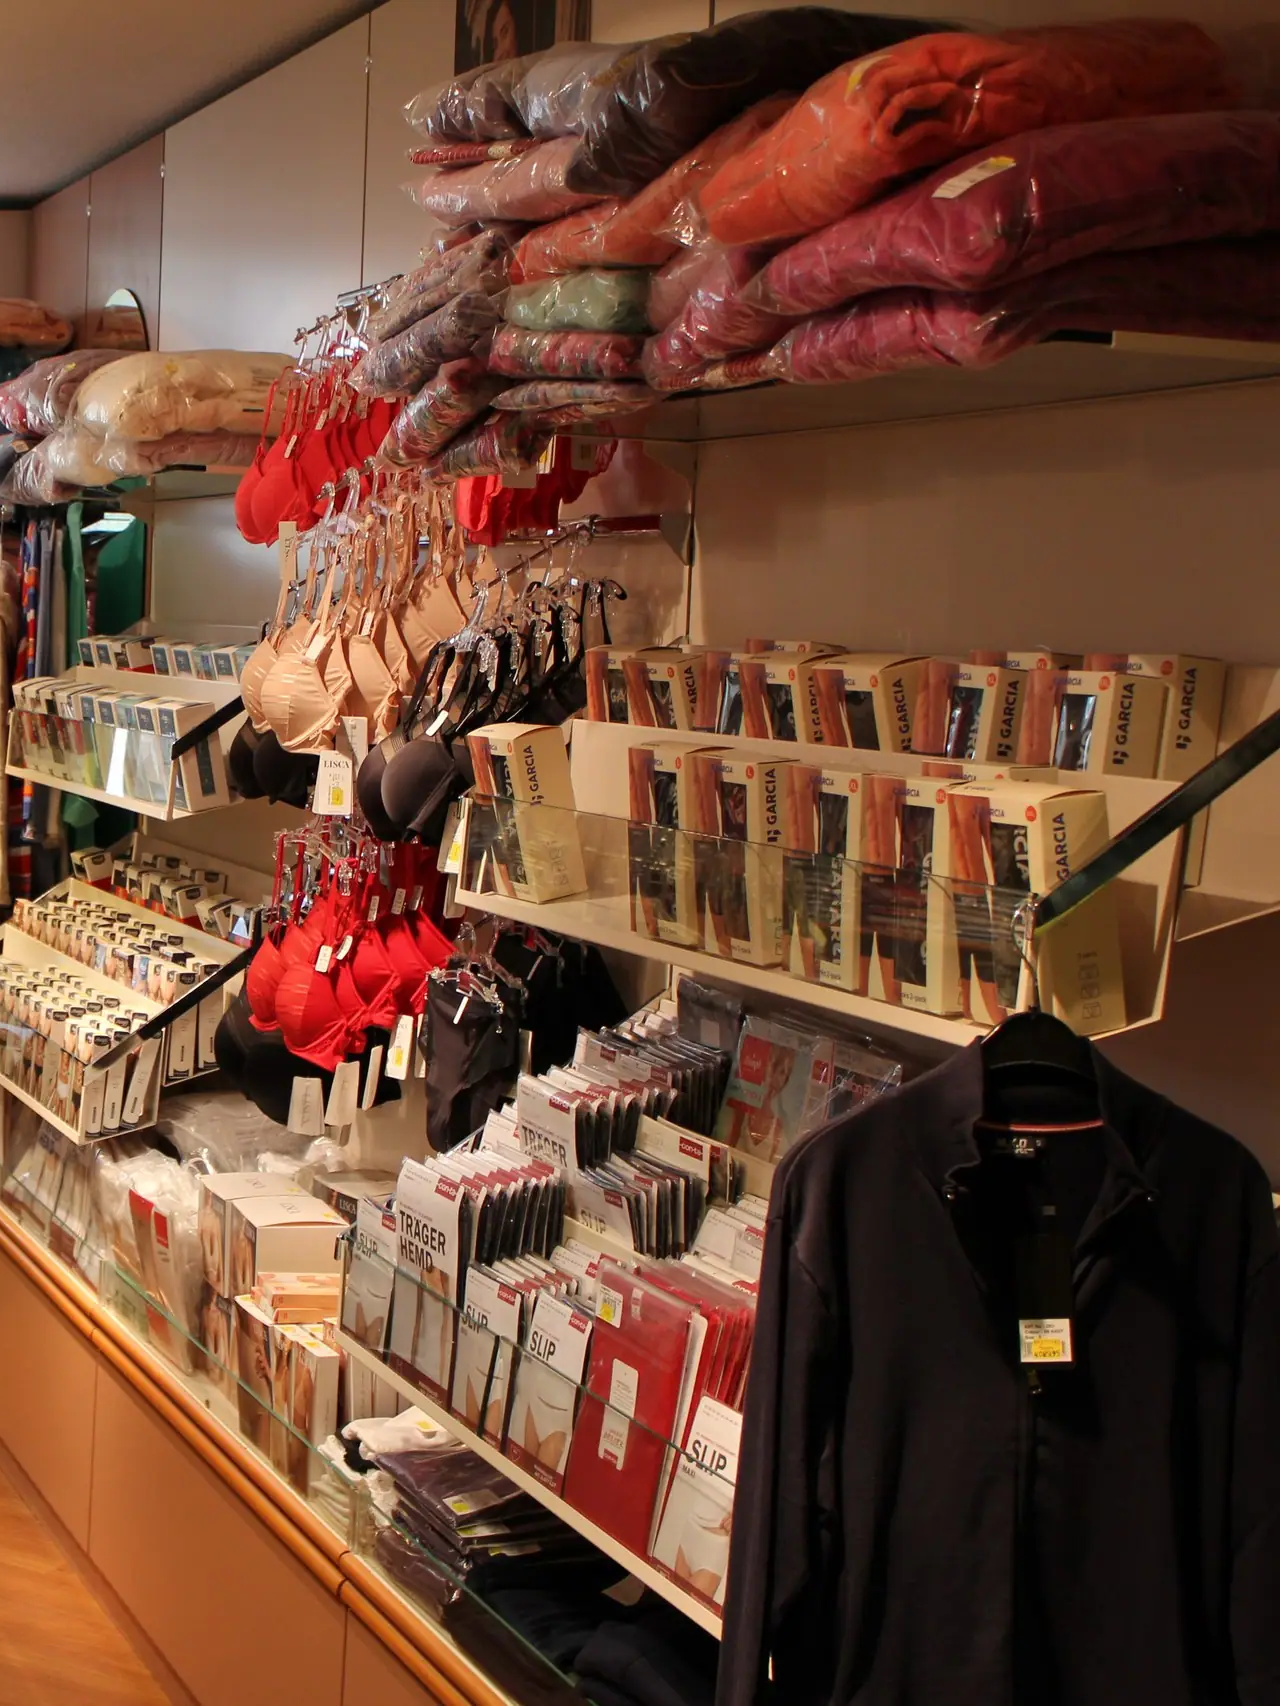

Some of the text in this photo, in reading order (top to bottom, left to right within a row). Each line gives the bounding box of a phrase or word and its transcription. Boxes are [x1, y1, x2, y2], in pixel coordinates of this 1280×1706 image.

[892, 678, 910, 734] GARCIA
[1001, 680, 1020, 738] GARCIA
[1117, 683, 1135, 745] GARCIA
[1179, 667, 1197, 730] GARCIA
[324, 761, 350, 769] LISCA
[525, 745, 540, 794] GARCIA
[765, 768, 777, 825] GARCIA
[1053, 812, 1070, 881] GARCIA
[339, 1199, 356, 1215] LISCA
[399, 1210, 446, 1256] TRÄGER
[399, 1235, 434, 1273] HEMD
[462, 1304, 488, 1334] SLIP
[529, 1330, 556, 1362] SLIP
[682, 1464, 696, 1479] MAXI
[685, 1438, 727, 1477] SLIP
